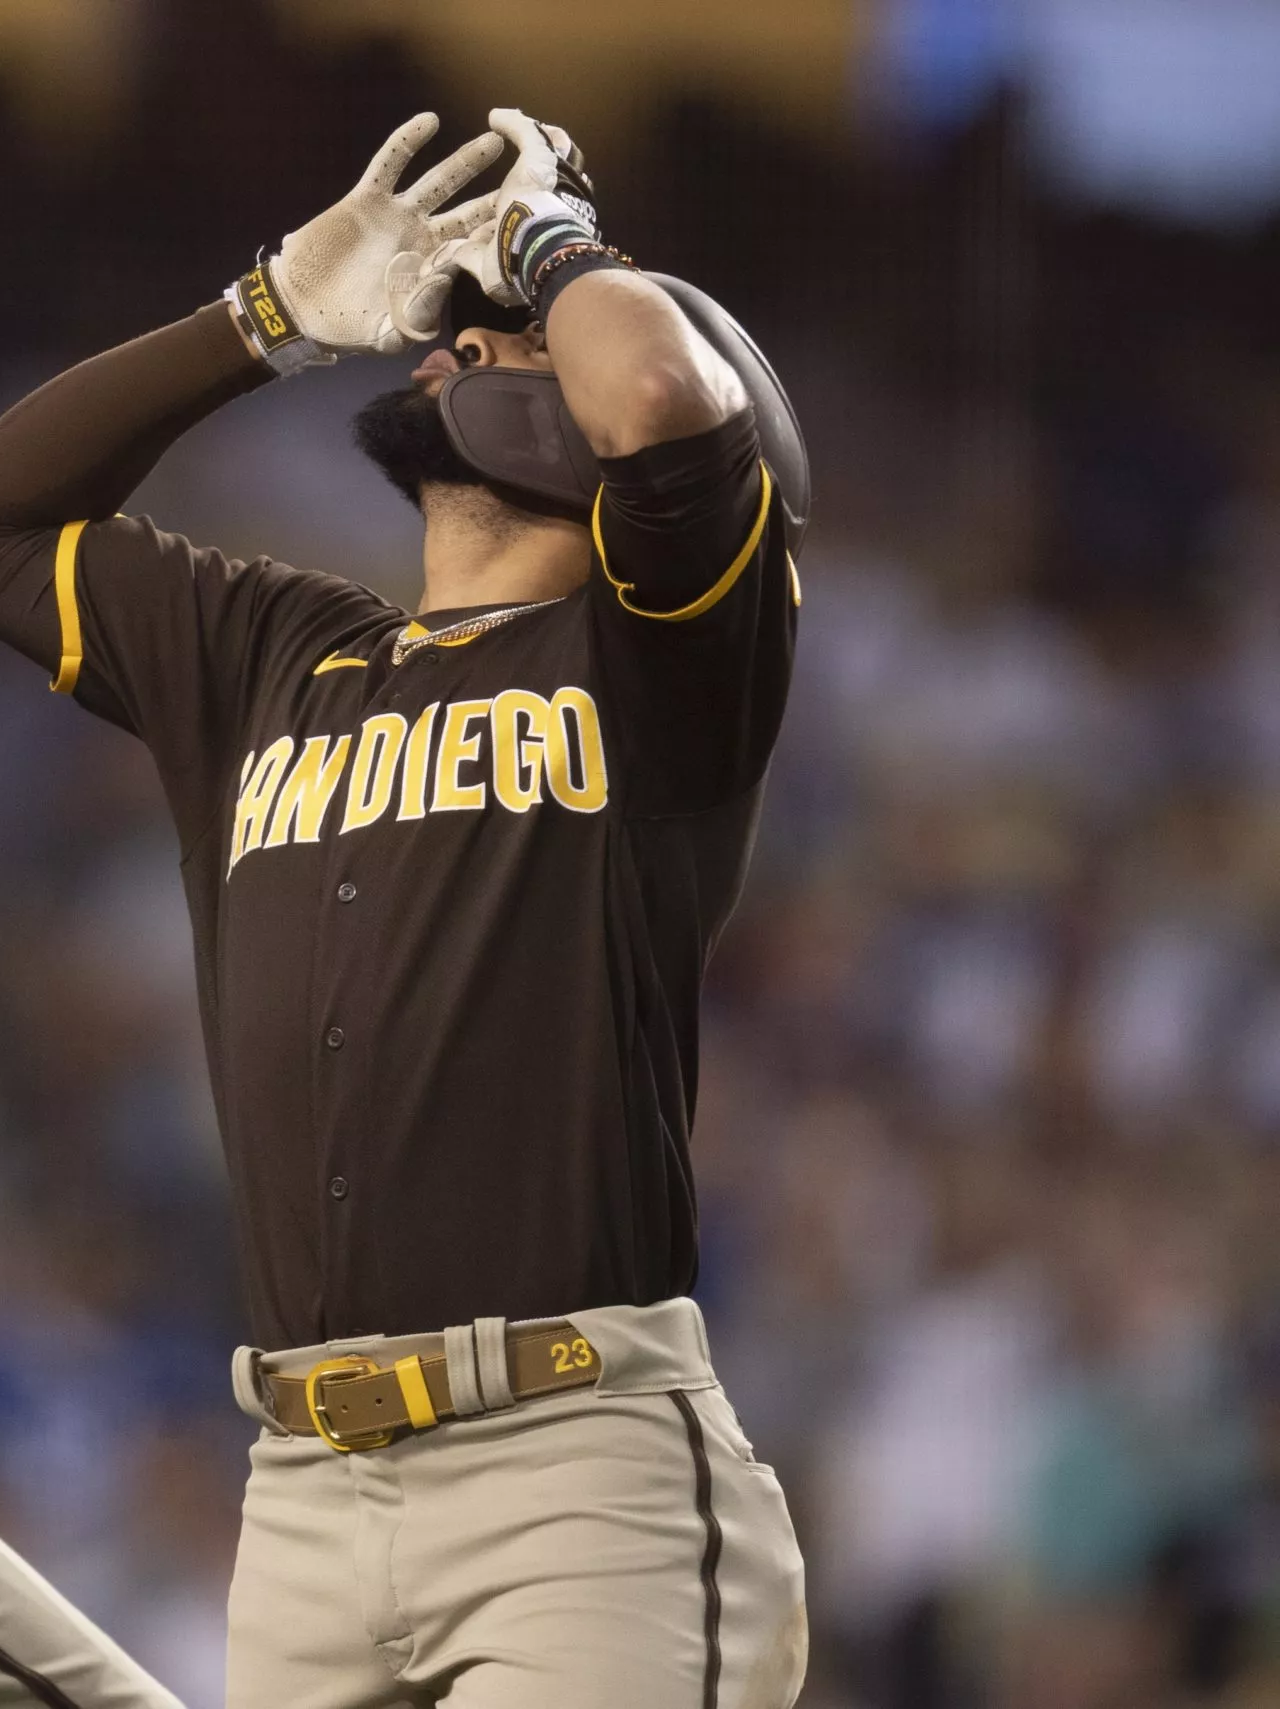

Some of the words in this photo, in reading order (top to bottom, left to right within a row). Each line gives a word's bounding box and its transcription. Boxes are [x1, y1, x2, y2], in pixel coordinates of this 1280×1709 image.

[227, 734, 352, 884] AN
[339, 686, 608, 836] DIEGO
[551, 1338, 593, 1374] 23
